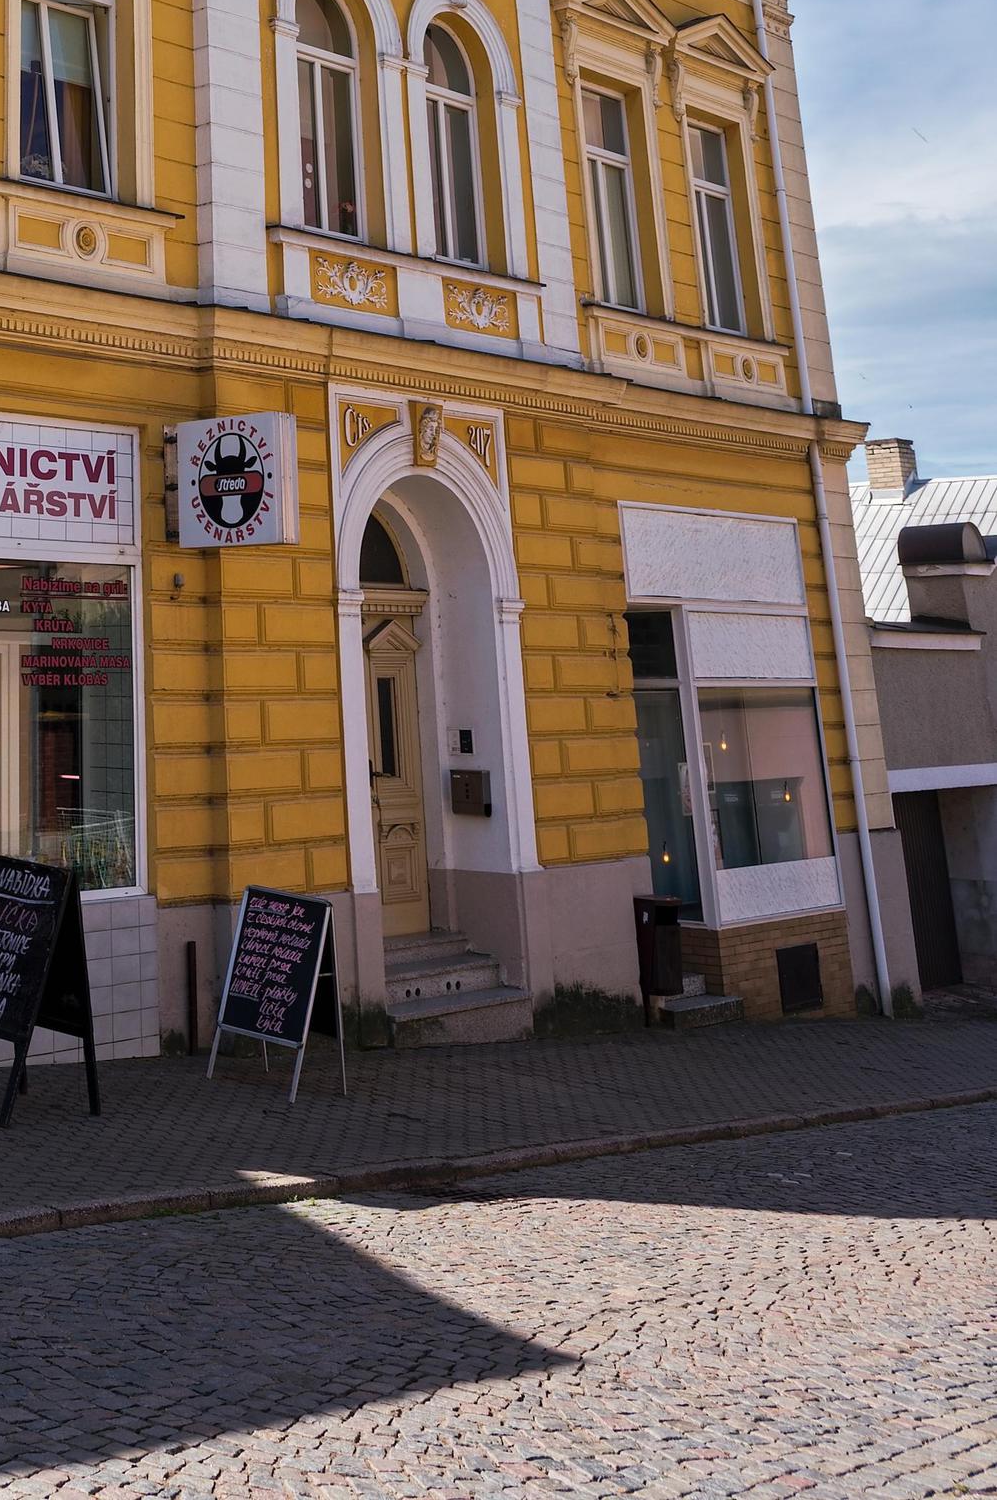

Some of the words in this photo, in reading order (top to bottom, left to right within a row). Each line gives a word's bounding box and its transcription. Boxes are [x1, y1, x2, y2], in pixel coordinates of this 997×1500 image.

[190, 418, 273, 467] ŘEZNICTVÍ
[467, 425, 491, 467] 207
[190, 490, 274, 544] UZENÁŘSTVÍ
[21, 576, 81, 592] Nabízíme
[84, 581, 100, 592] na
[103, 580, 128, 596] gril:
[21, 598, 53, 613] KÝTA
[52, 637, 110, 650] KRKOVICE
[21, 653, 97, 668] MARINOVANÁ
[99, 655, 130, 668] MASA
[22, 671, 60, 686] VÝBĚR
[63, 670, 108, 685] KLOBÁS
